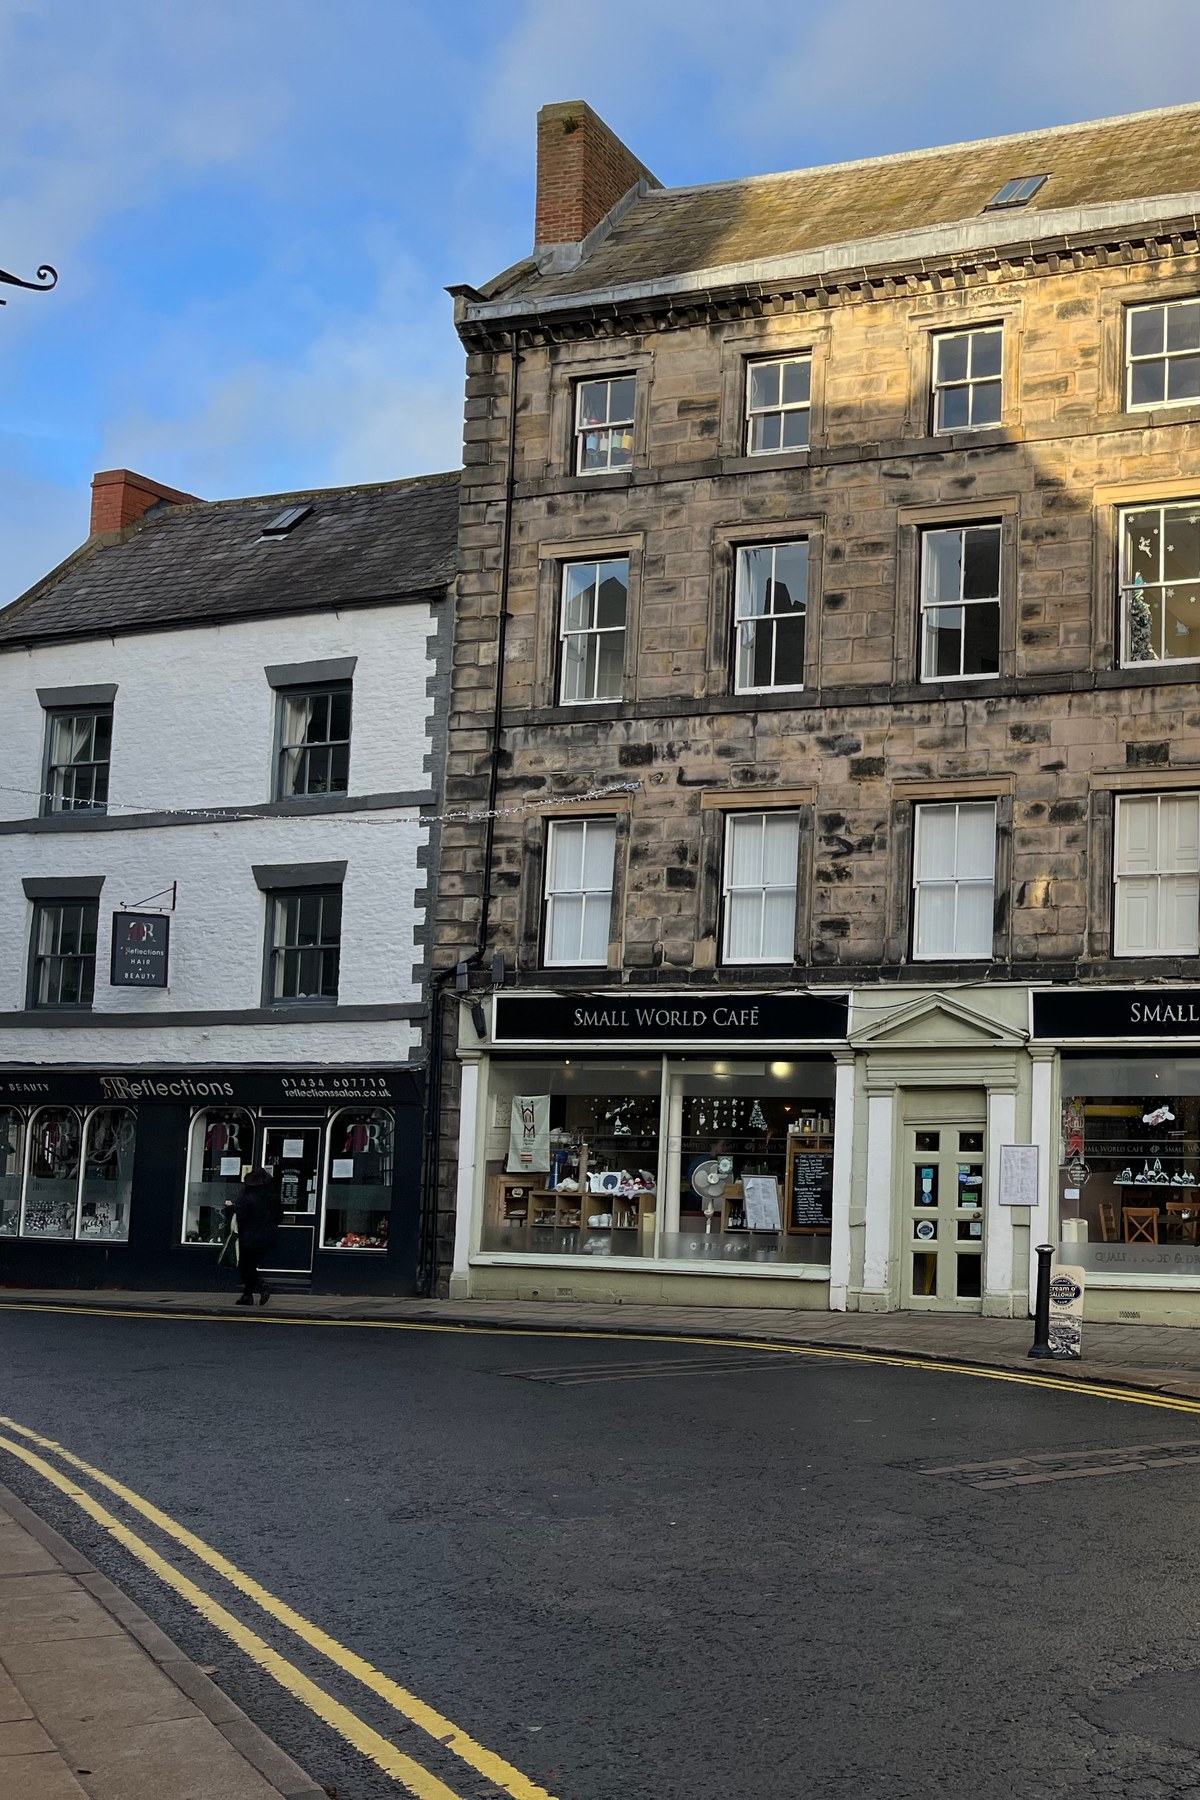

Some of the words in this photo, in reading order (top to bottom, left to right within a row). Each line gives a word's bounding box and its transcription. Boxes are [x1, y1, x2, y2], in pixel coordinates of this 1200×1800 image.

[574, 1008, 630, 1026] SMALL
[635, 1008, 707, 1026] WORLD
[1131, 1003, 1200, 1022] SMALL
[9, 1083, 50, 1092] BEAUTY
[281, 1078, 325, 1087] 01434
[333, 1078, 386, 1087] 607710
[100, 1077, 234, 1099] Reflections
[285, 1089, 392, 1098] reflectionssalon.co.uk
[1100, 1145, 1125, 1153] WORLD
[1174, 1253, 1182, 1264] &
